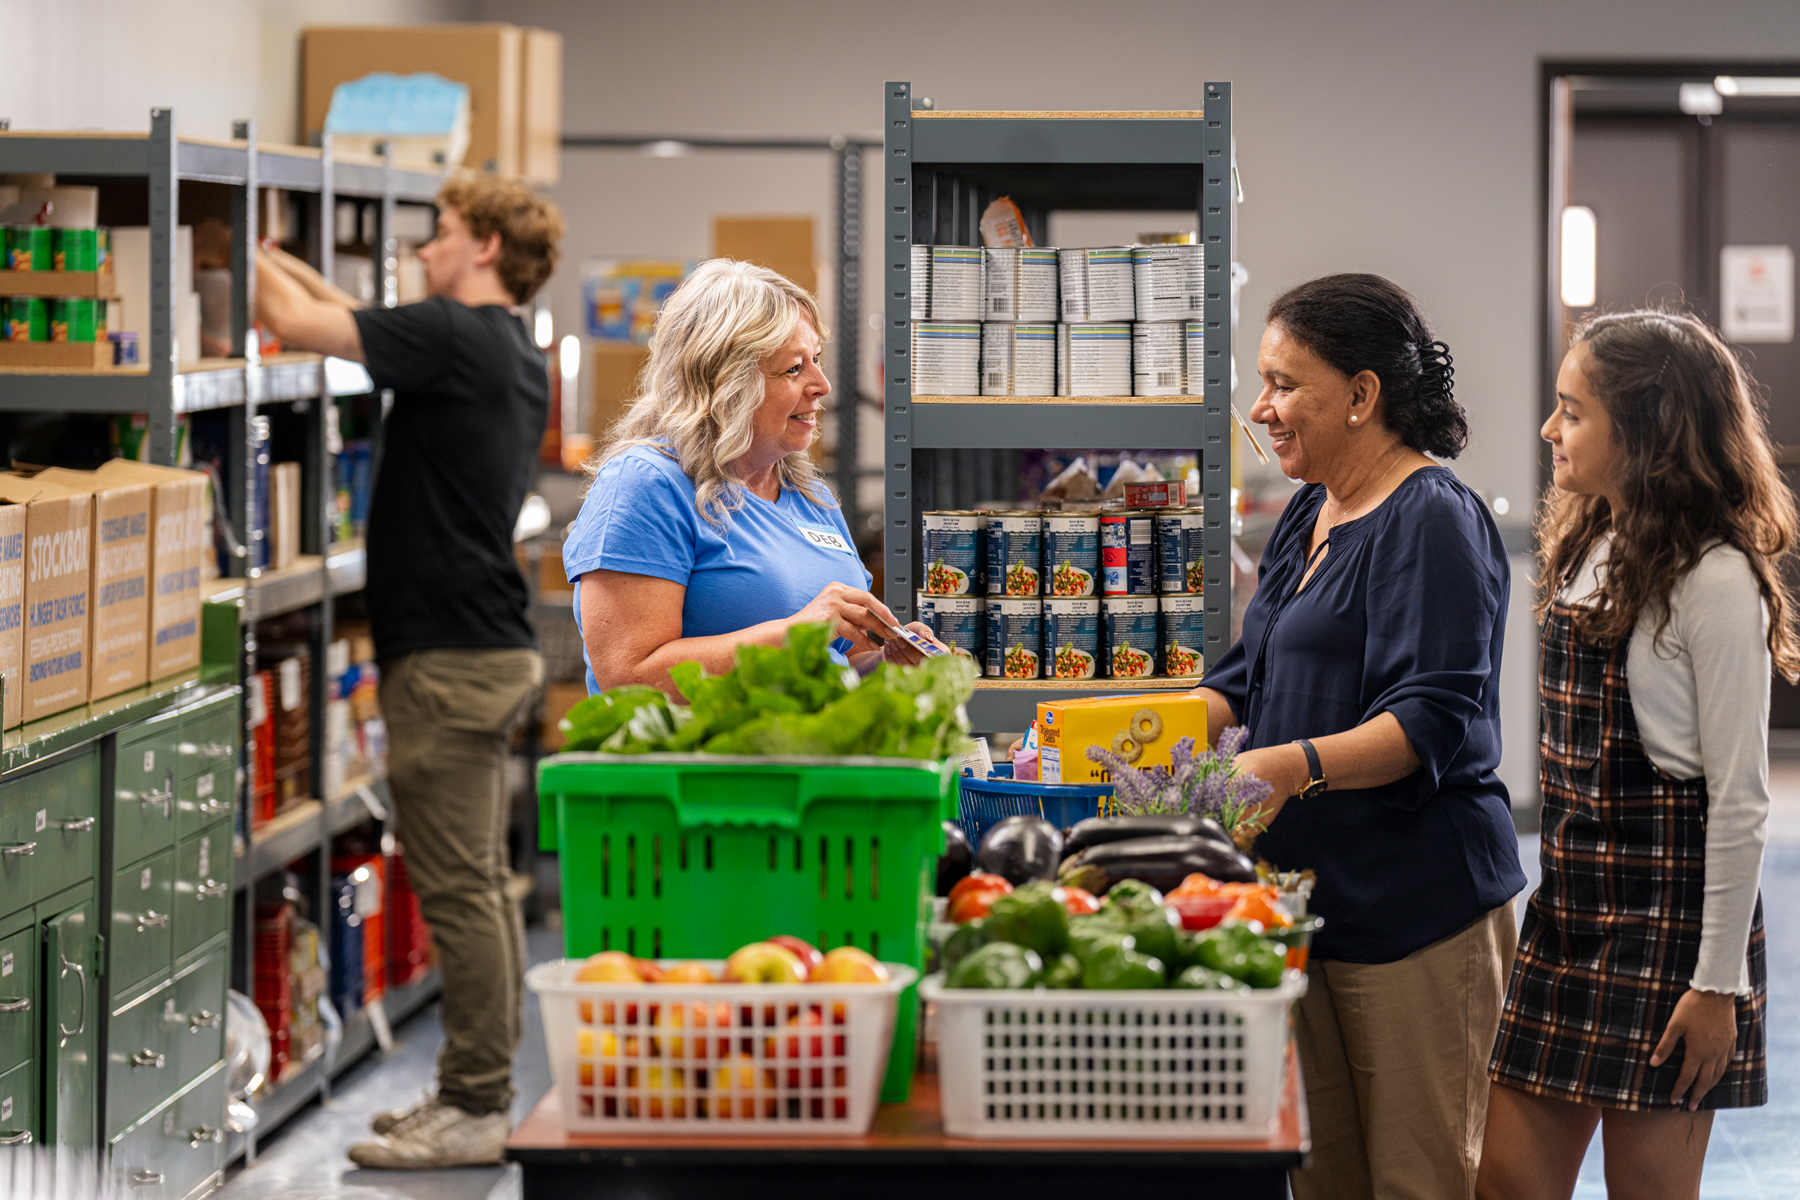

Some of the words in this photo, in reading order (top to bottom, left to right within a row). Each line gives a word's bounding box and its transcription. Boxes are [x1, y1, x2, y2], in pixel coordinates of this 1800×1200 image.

[807, 531, 842, 548] DEB
[30, 525, 88, 583] STOCKBOX
[30, 601, 54, 629] HUNGER
[54, 597, 68, 622] TASK
[69, 592, 86, 618] FORCE
[1040, 725, 1060, 738] Toasted
[1044, 734, 1055, 743] Oats
